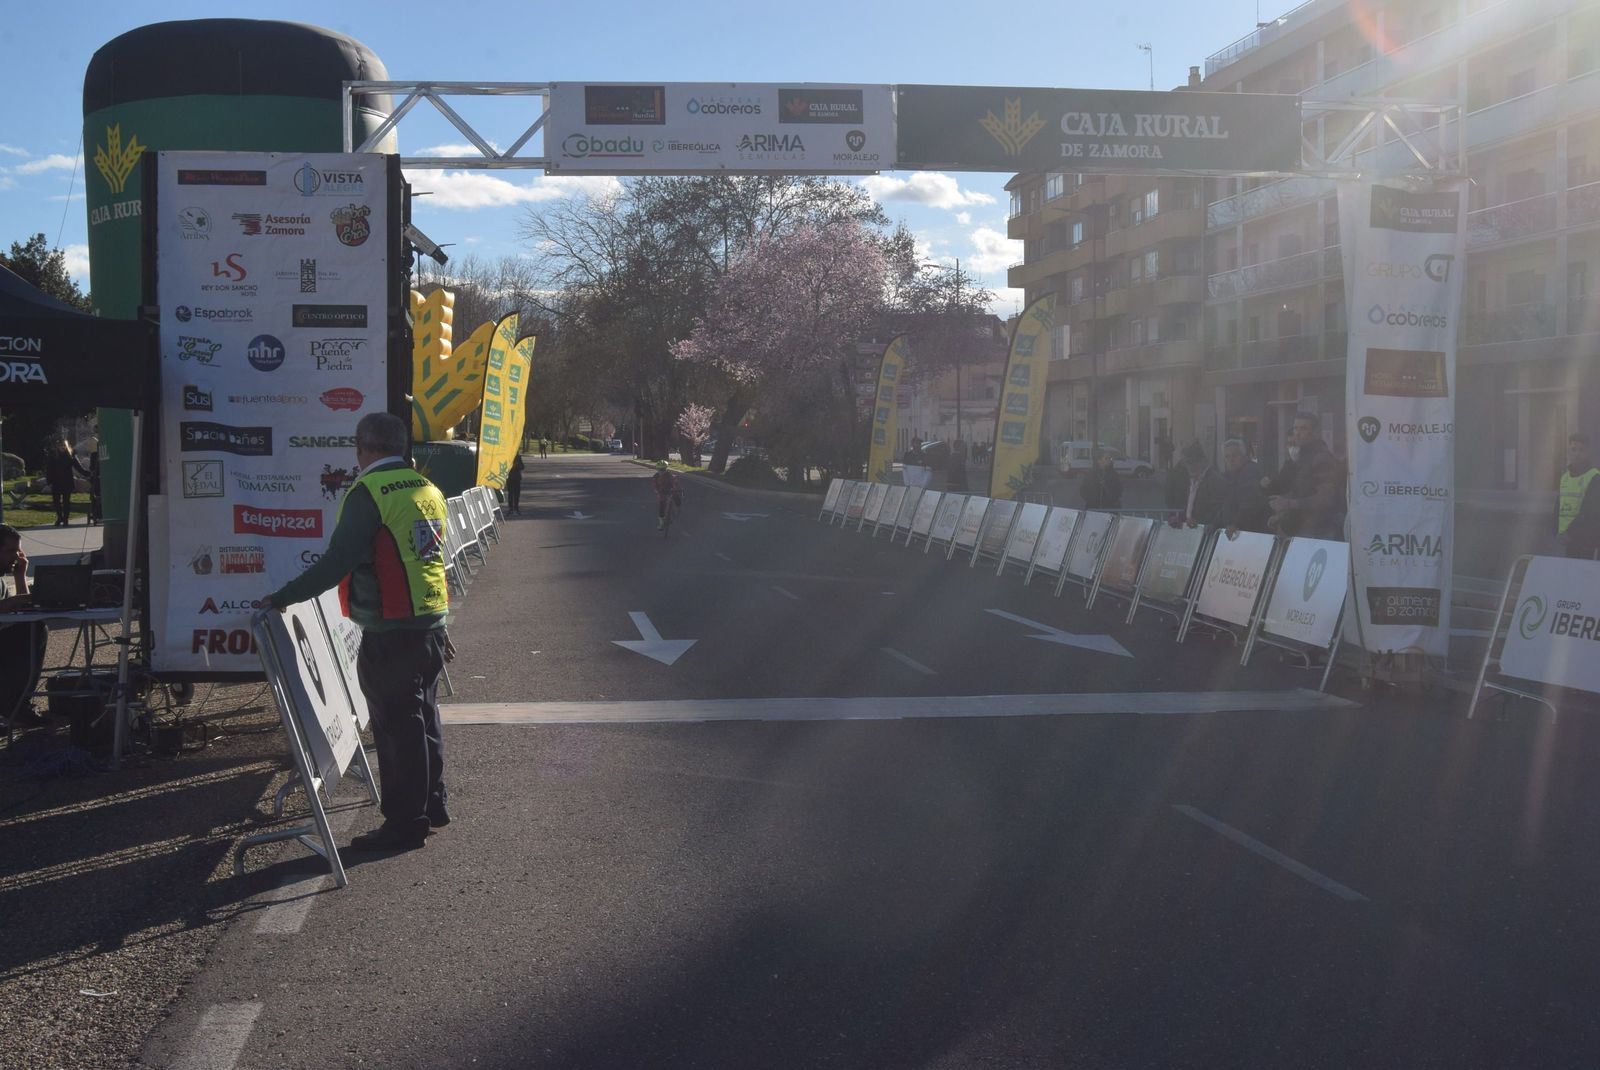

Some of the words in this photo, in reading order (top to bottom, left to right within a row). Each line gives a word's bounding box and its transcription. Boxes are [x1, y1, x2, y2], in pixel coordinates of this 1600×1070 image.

[701, 102, 761, 115] cobreros
[1060, 111, 1128, 137] CAJA
[1135, 113, 1229, 140] RURAL
[736, 133, 806, 152] ARIMA
[833, 153, 880, 161] MORALEJO
[1061, 143, 1083, 157] DE
[1089, 144, 1163, 159] ZAMORA
[322, 173, 364, 184] VISTA
[92, 207, 111, 225] CAJA
[265, 213, 311, 224] Asesoría
[265, 227, 305, 236] Zamora
[194, 307, 253, 320] Espabrok
[247, 341, 280, 358] nhr
[310, 340, 351, 356] Puente
[316, 355, 353, 371] Piedra
[236, 479, 296, 493] TOMASITA
[241, 511, 316, 532] telepizza
[1556, 600, 1582, 611] GRUPO
